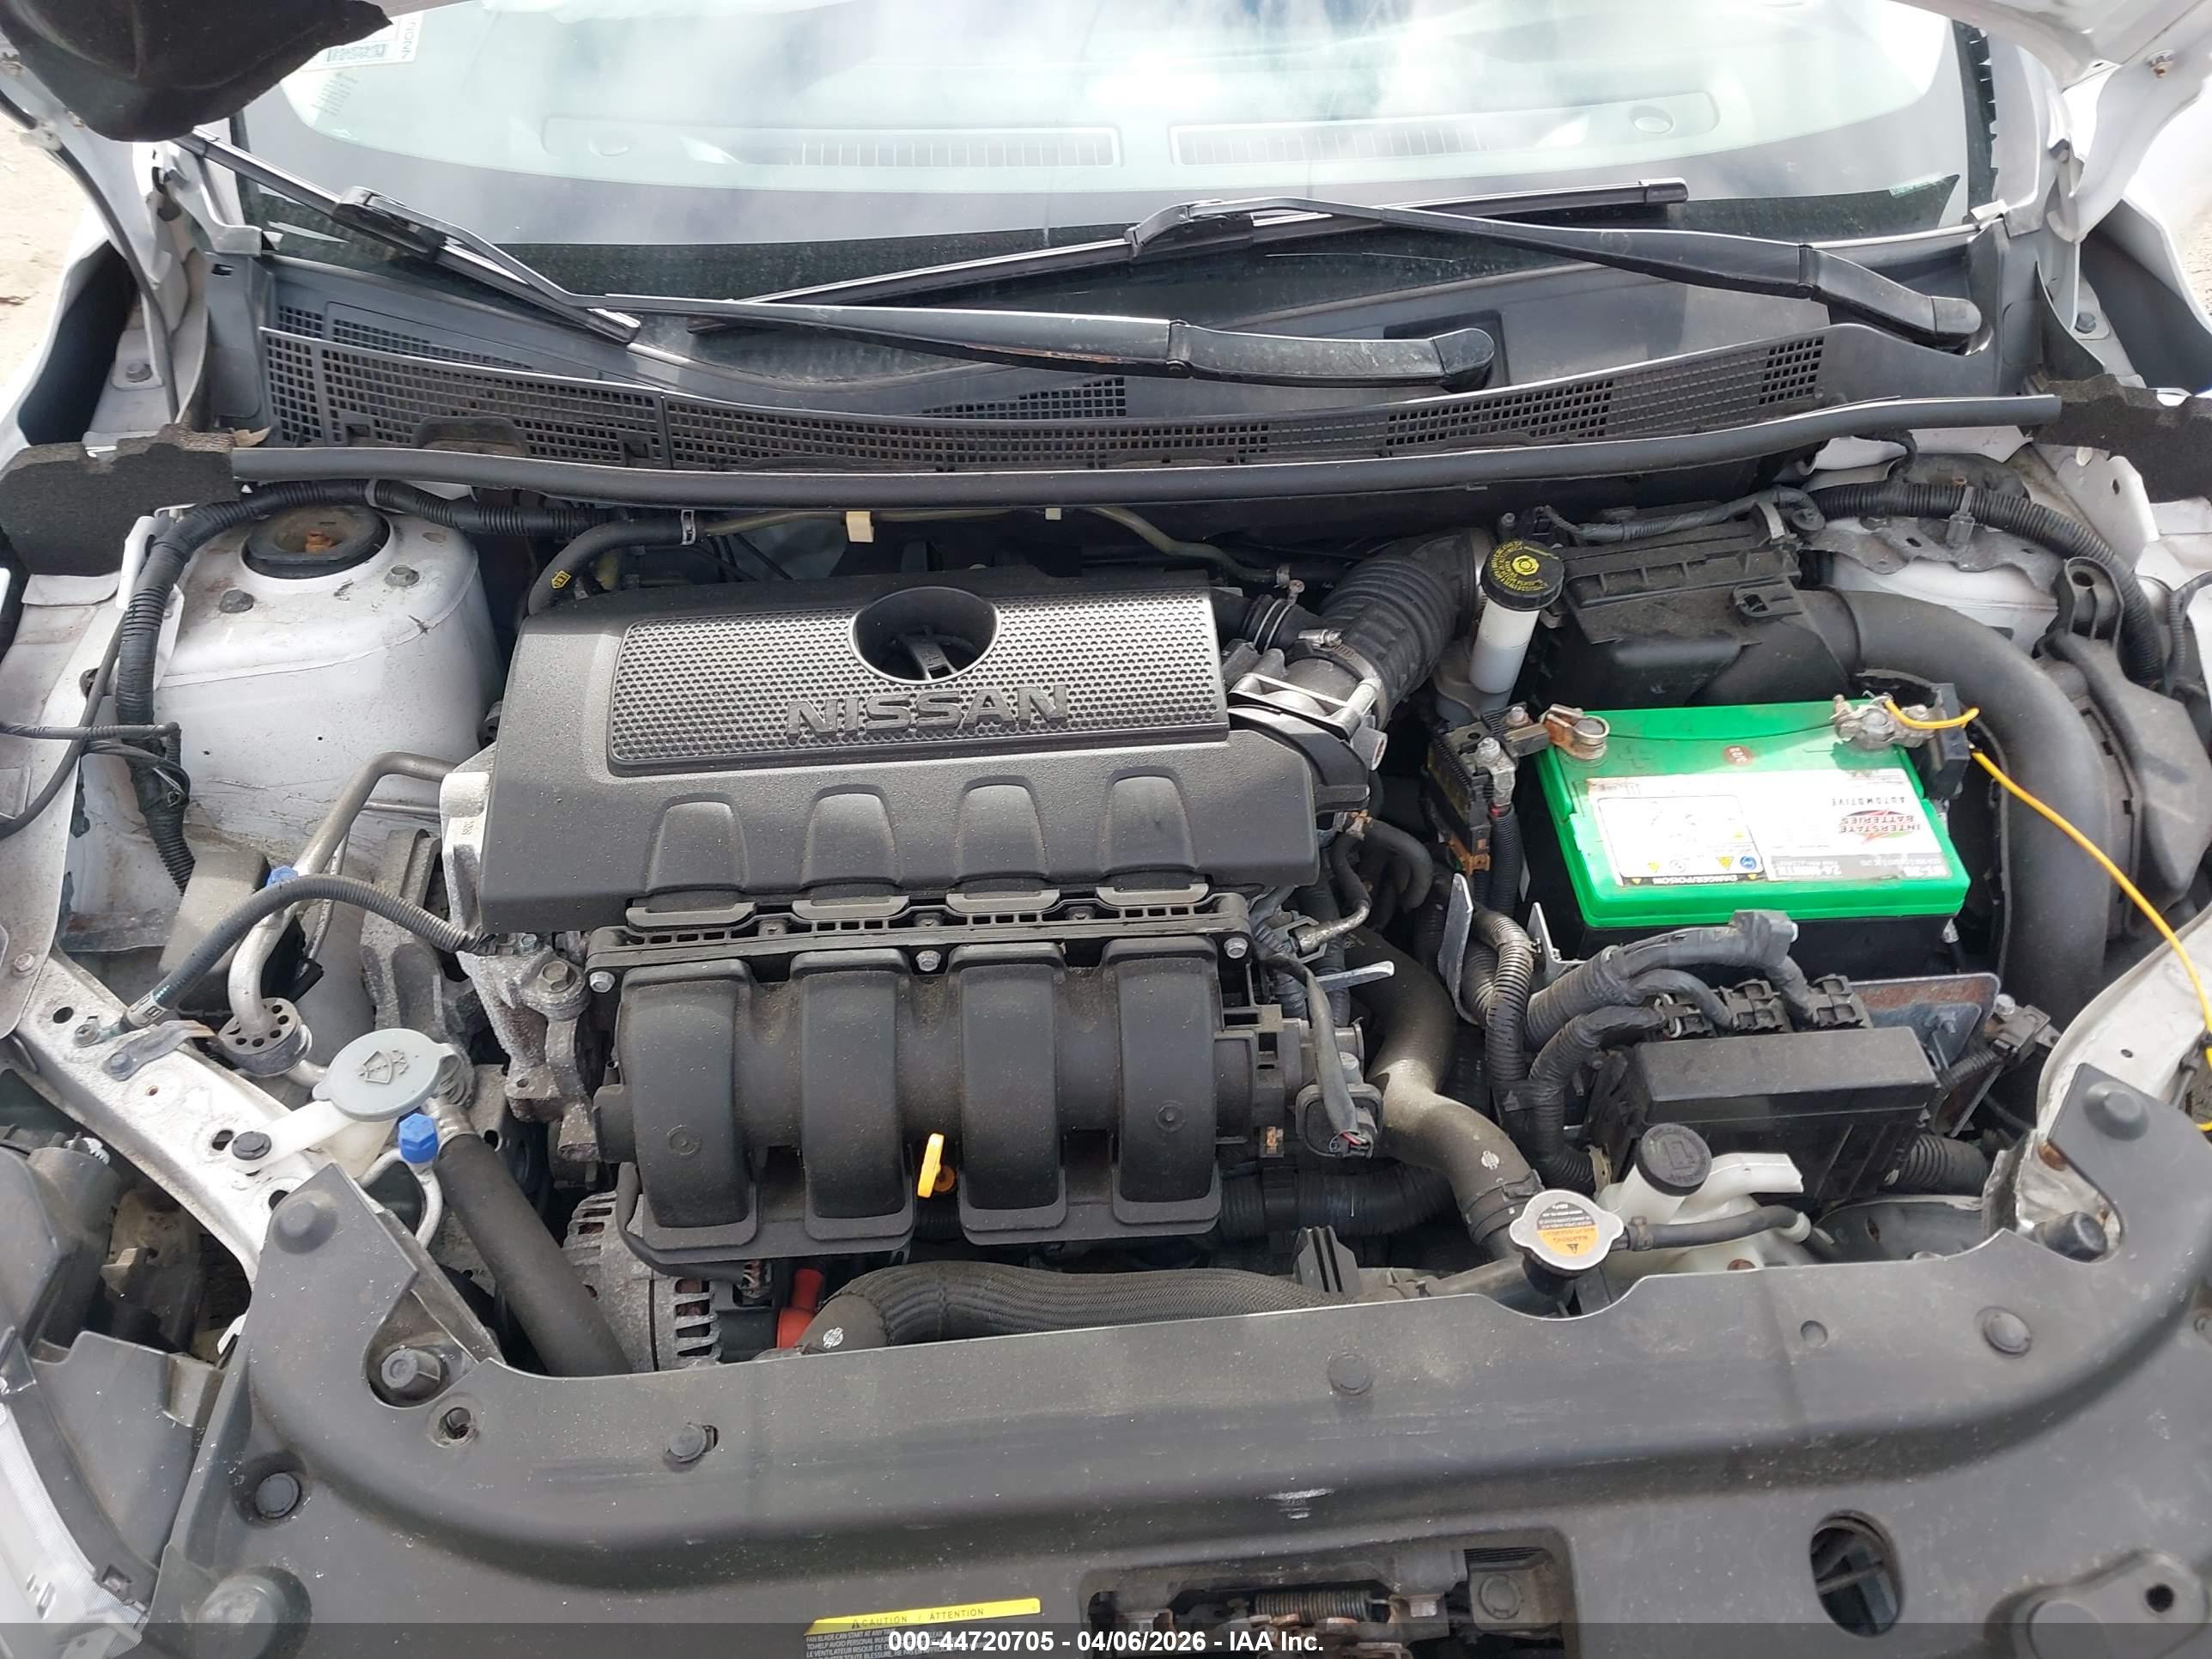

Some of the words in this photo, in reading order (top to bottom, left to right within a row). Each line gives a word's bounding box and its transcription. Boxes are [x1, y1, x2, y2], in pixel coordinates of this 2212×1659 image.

[785, 684, 1068, 740] NISSAN
[1831, 796, 1905, 806] AUTOMOTIVE
[1839, 816, 1914, 825] BATTERIES
[1838, 823, 1921, 834] INTERSTATE
[862, 1615, 907, 1626] CAUTION
[929, 1608, 984, 1621] ATTENTION
